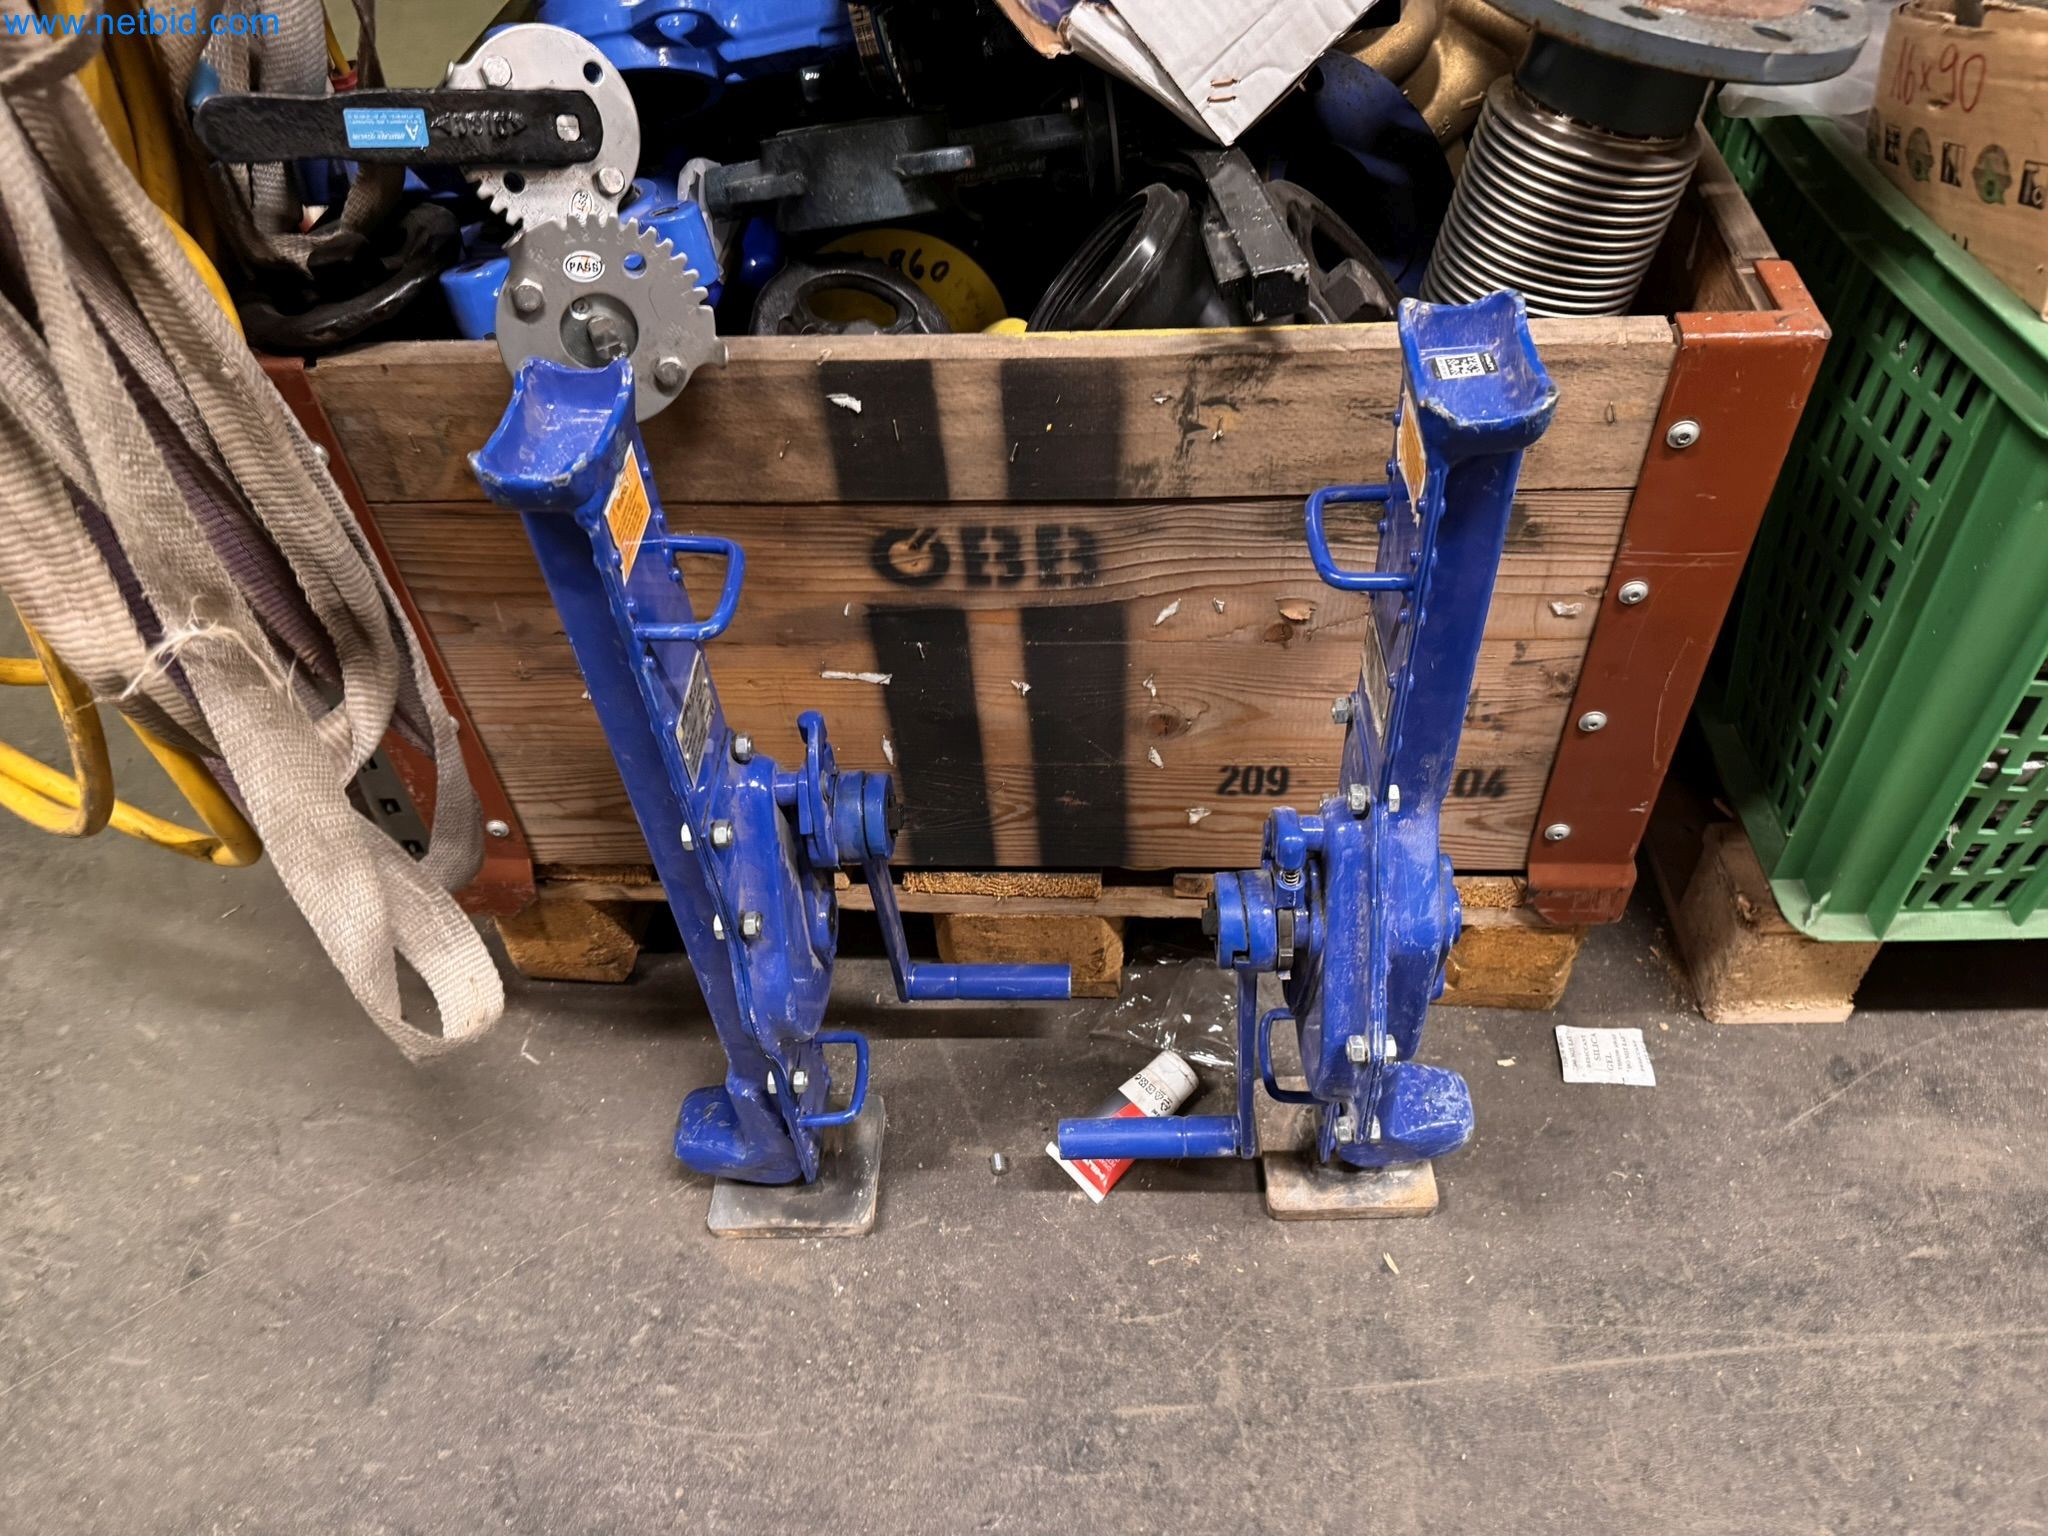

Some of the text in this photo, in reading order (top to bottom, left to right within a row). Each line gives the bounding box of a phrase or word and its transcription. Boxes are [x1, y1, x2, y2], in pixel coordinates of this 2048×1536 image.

[1889, 37, 1986, 113] 16x90
[568, 261, 600, 273] PASS
[1217, 765, 1290, 797] 209
[1590, 1032, 1601, 1062] SILICA
[1605, 1052, 1614, 1071] GEL
